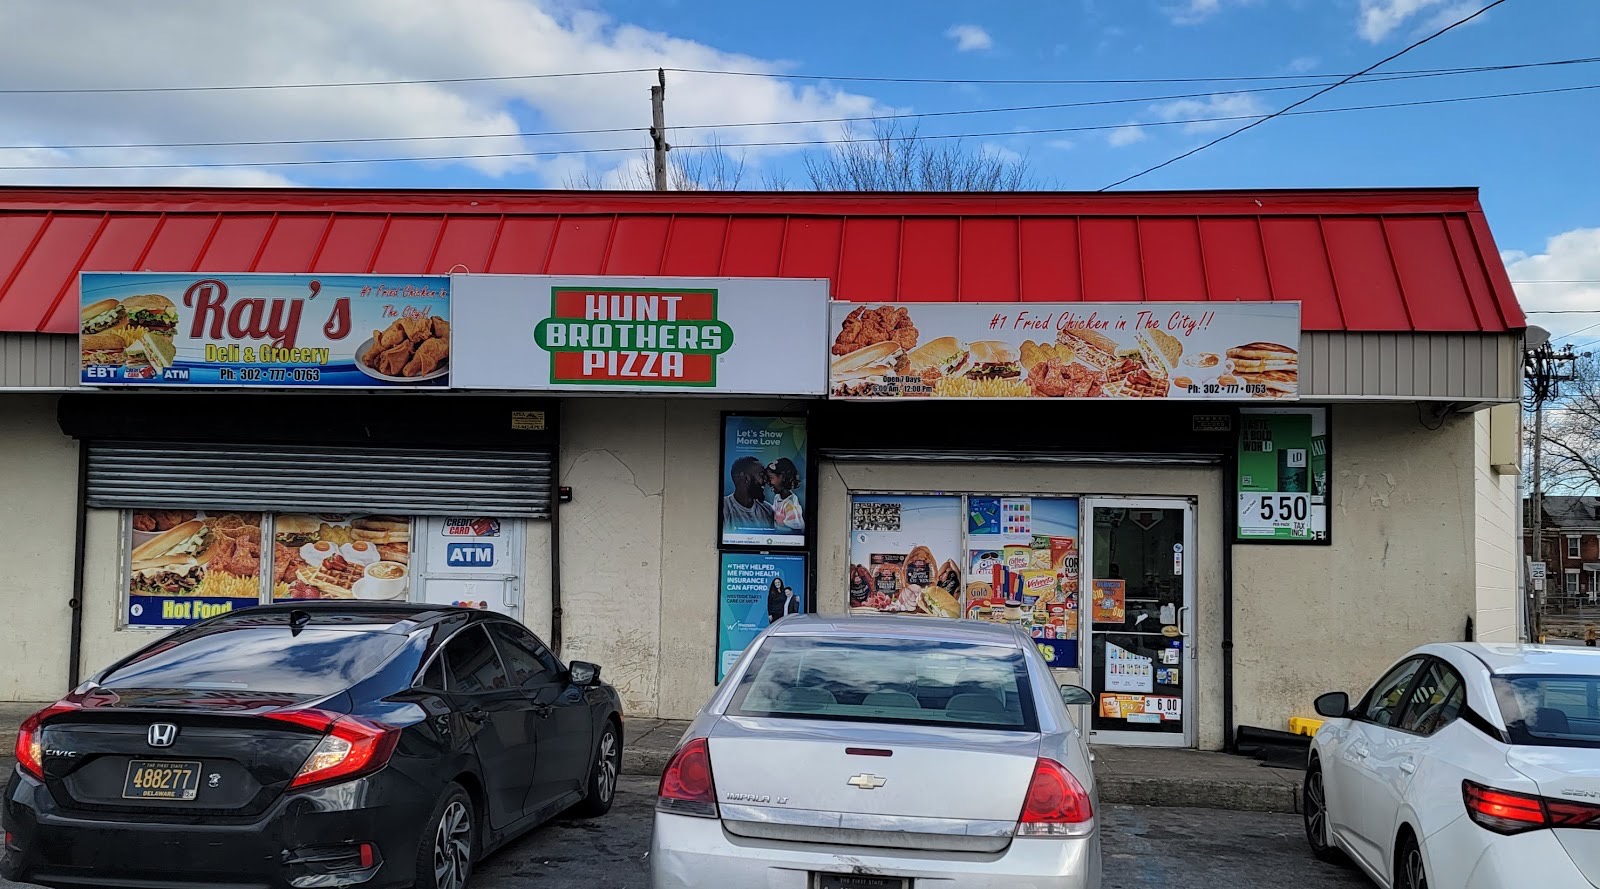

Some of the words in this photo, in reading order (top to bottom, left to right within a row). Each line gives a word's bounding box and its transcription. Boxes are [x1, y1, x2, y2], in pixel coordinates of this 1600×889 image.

[375, 283, 400, 297] Fried
[402, 284, 436, 298] Chicken
[182, 278, 353, 350] Ray's
[382, 304, 398, 318] The
[585, 295, 683, 322] HUNT
[989, 313, 1008, 329] #1
[1013, 311, 1053, 330] Fried
[1056, 311, 1109, 331] Chicken
[1115, 315, 1127, 330] in
[1135, 310, 1160, 331] The
[1167, 310, 1216, 337] City!!
[546, 323, 723, 350] BROTHERS
[205, 343, 240, 362] Deli
[243, 346, 256, 363] &
[259, 344, 329, 365] Grocery
[583, 350, 684, 378] PIZZA
[87, 367, 117, 378] EBT
[164, 370, 189, 379] ATM
[220, 368, 236, 380] Ph:
[882, 375, 900, 383] Open
[905, 375, 922, 383] Days
[1188, 384, 1201, 394] Ph:
[759, 430, 783, 438] Show
[1250, 430, 1273, 440] BOLD
[736, 437, 758, 445] More
[760, 438, 781, 446] Love
[1243, 441, 1273, 452] WORLD
[1260, 496, 1307, 522] 5.50
[446, 518, 474, 527] CREDIT
[1293, 522, 1305, 530] TAX
[449, 526, 470, 535] CARD
[450, 547, 491, 562] ATM
[1533, 570, 1545, 578] 25
[162, 600, 191, 619] Hot
[1146, 699, 1150, 707] $
[1157, 698, 1177, 711] 6.00
[45, 749, 77, 758] CIVIC
[133, 768, 192, 789] 488277
[726, 792, 770, 803] IMPALA
[777, 796, 788, 804] LT
